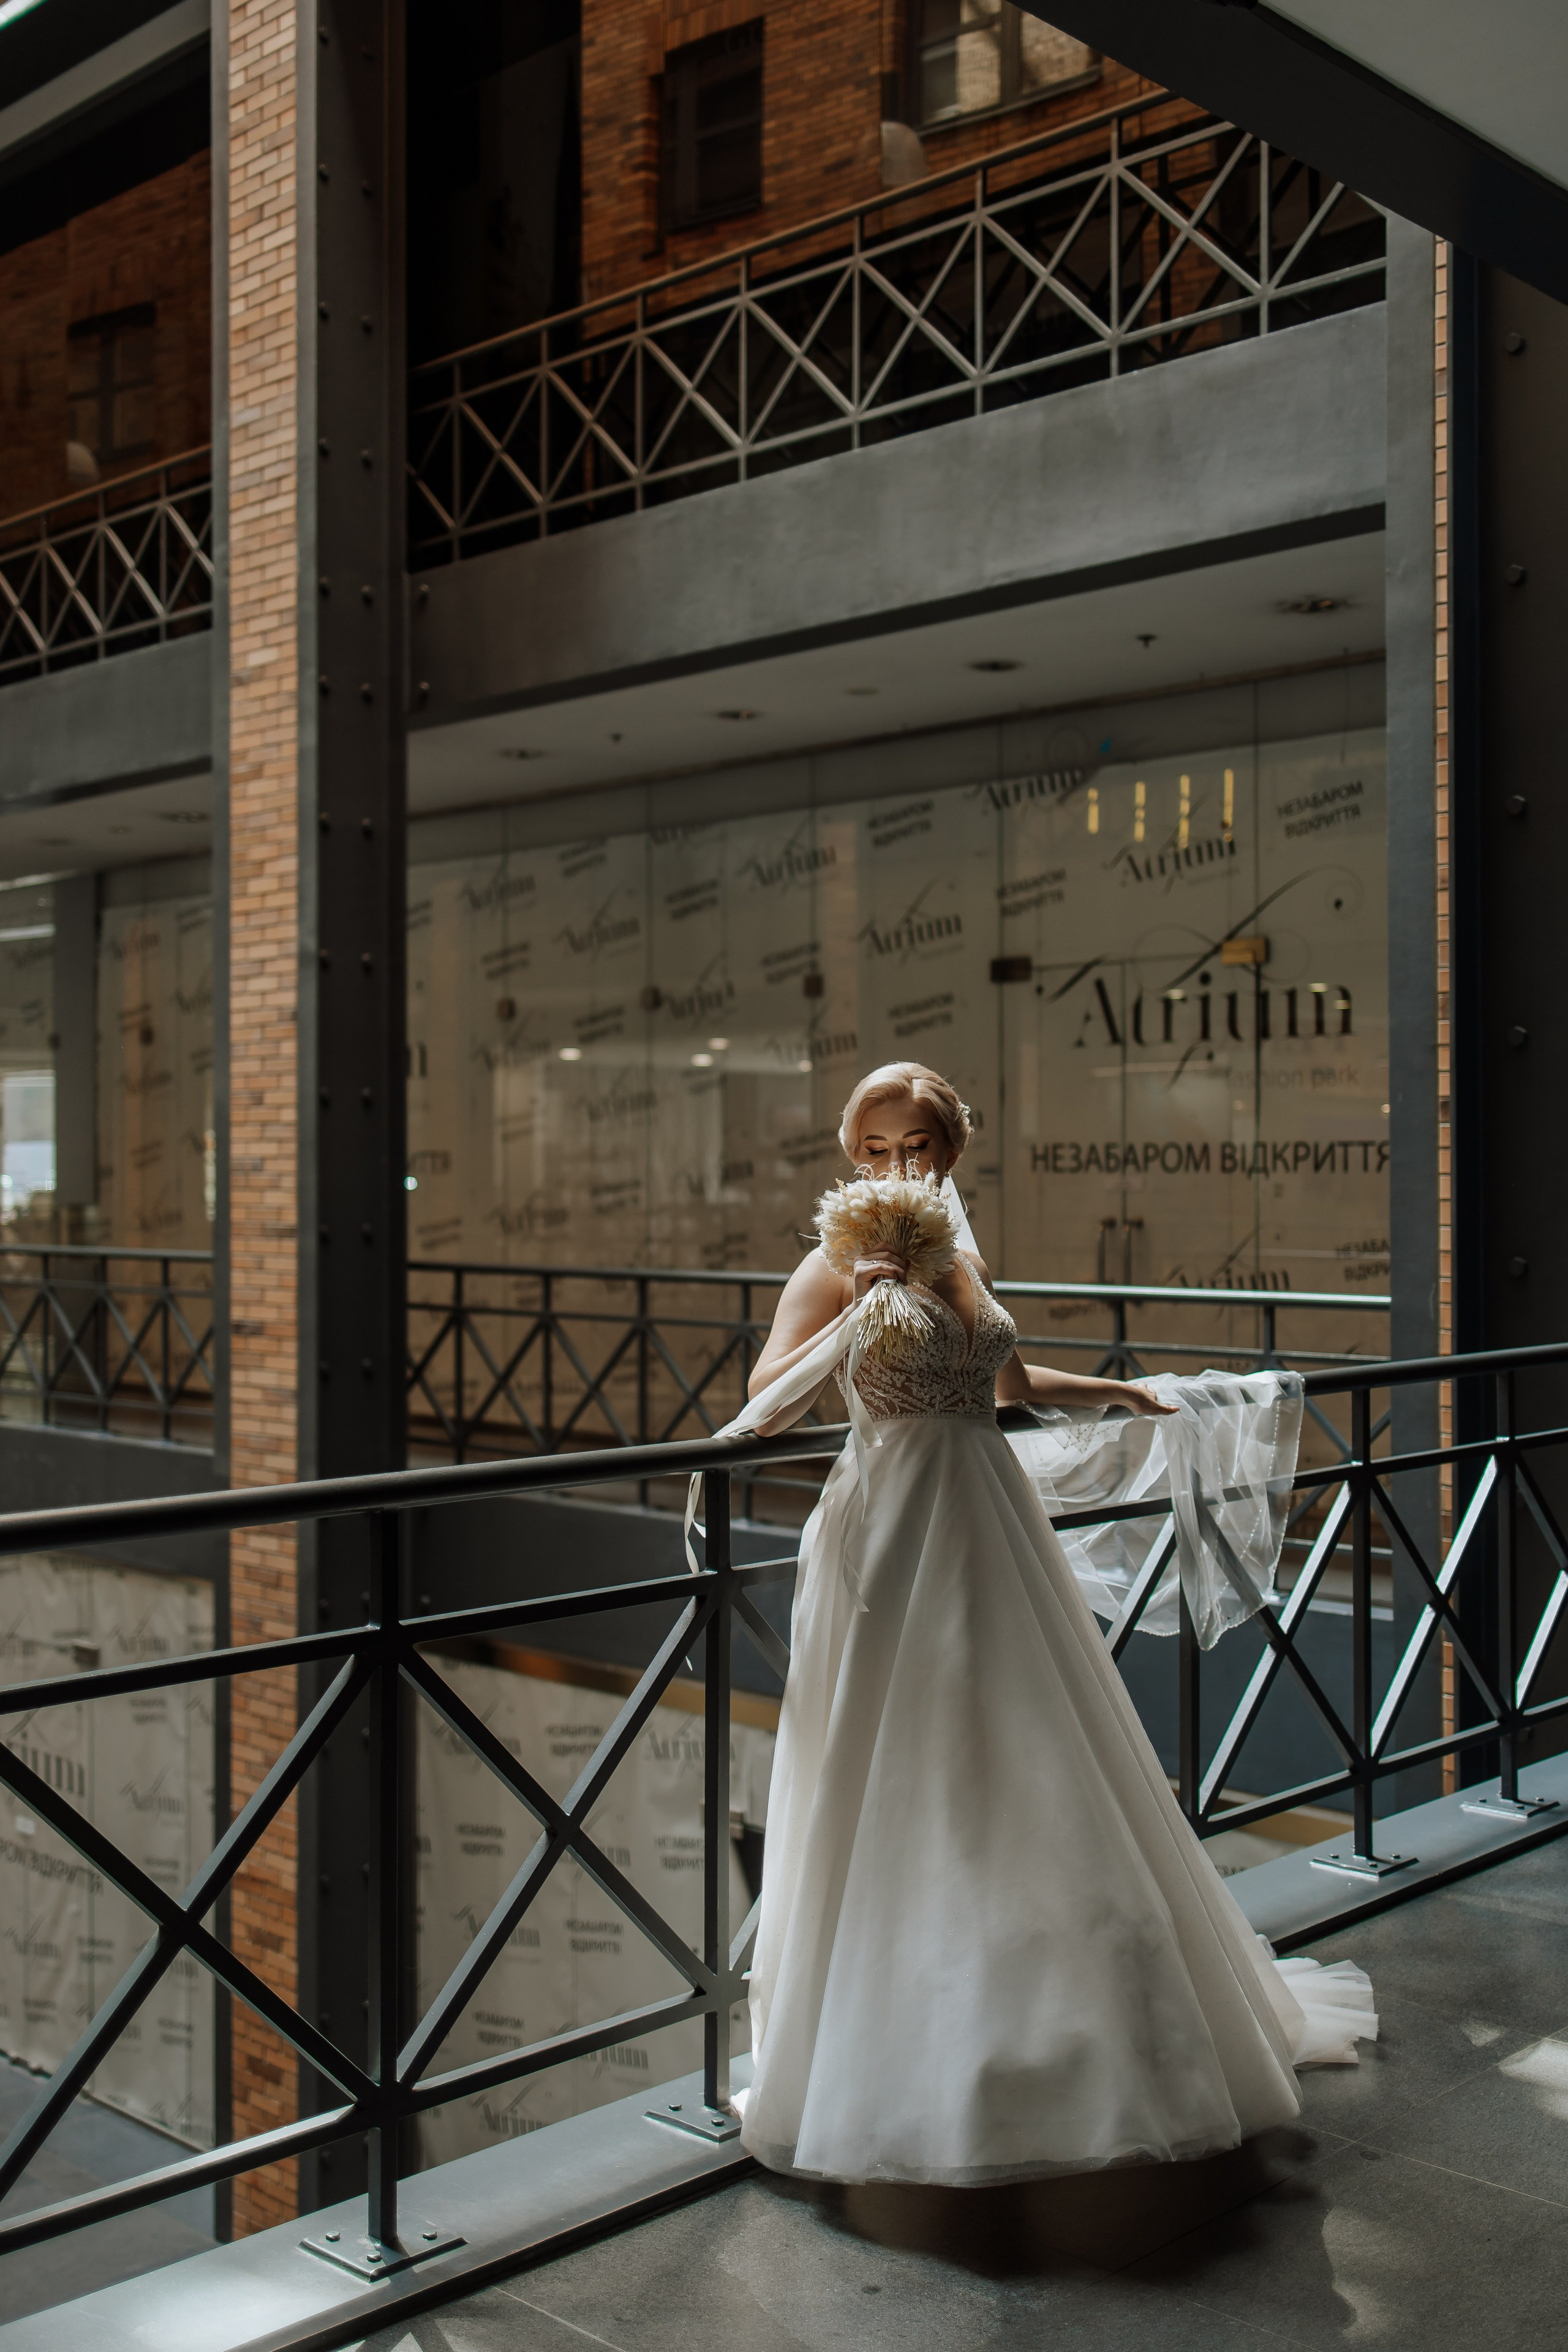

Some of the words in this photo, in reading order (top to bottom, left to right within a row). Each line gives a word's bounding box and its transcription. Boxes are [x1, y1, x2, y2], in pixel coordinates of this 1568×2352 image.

[1051, 959, 1355, 1049] Atrium
[1030, 1141, 1212, 1175] НЕЗАБАРОМ
[1220, 1139, 1390, 1180] ВІДКРИТТЯ
